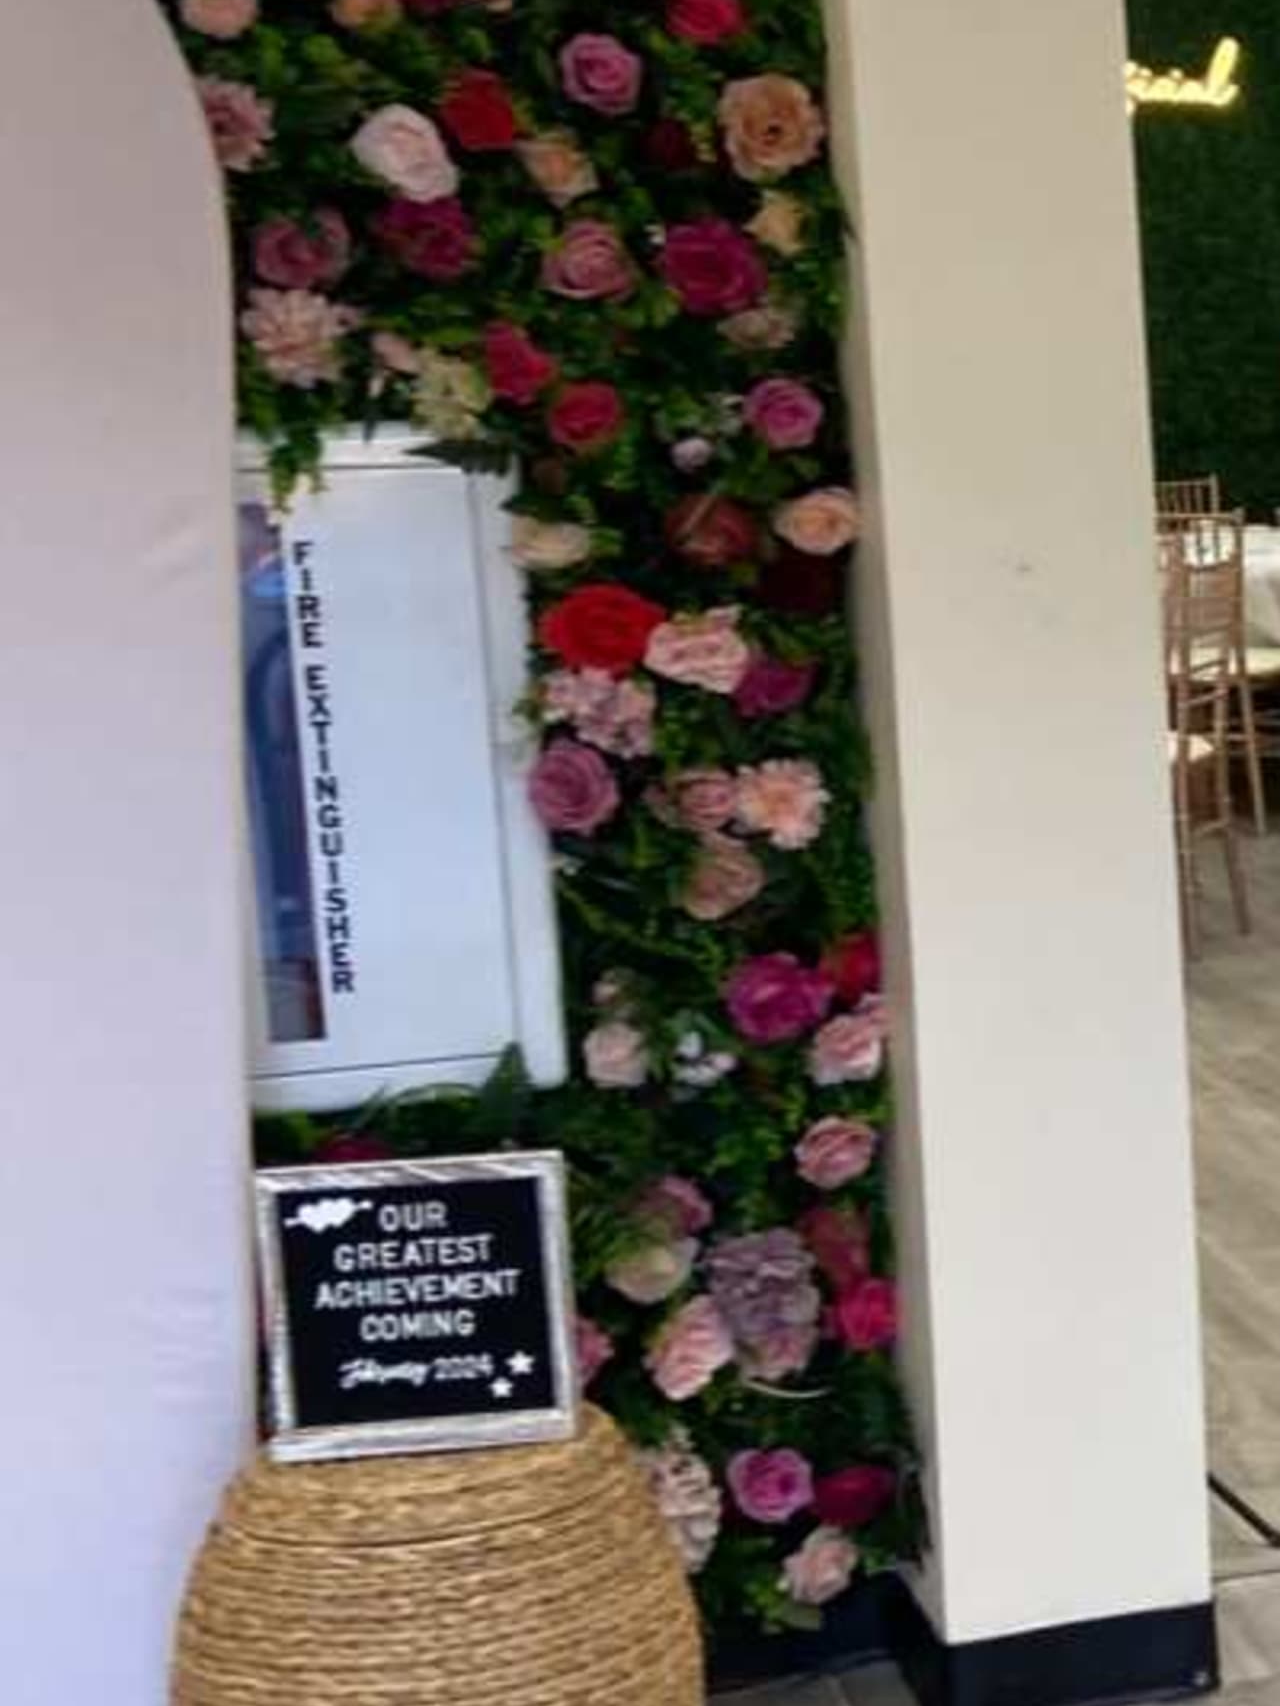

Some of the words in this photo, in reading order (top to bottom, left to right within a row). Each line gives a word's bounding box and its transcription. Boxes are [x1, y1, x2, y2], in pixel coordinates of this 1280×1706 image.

[293, 541, 324, 648] FIRE
[306, 665, 355, 994] EXTINGUISHER
[378, 1201, 447, 1232] OUR
[334, 1234, 494, 1271] GREATEST
[314, 1268, 522, 1310] ACHIEVEMENT
[359, 1309, 476, 1341] COMING
